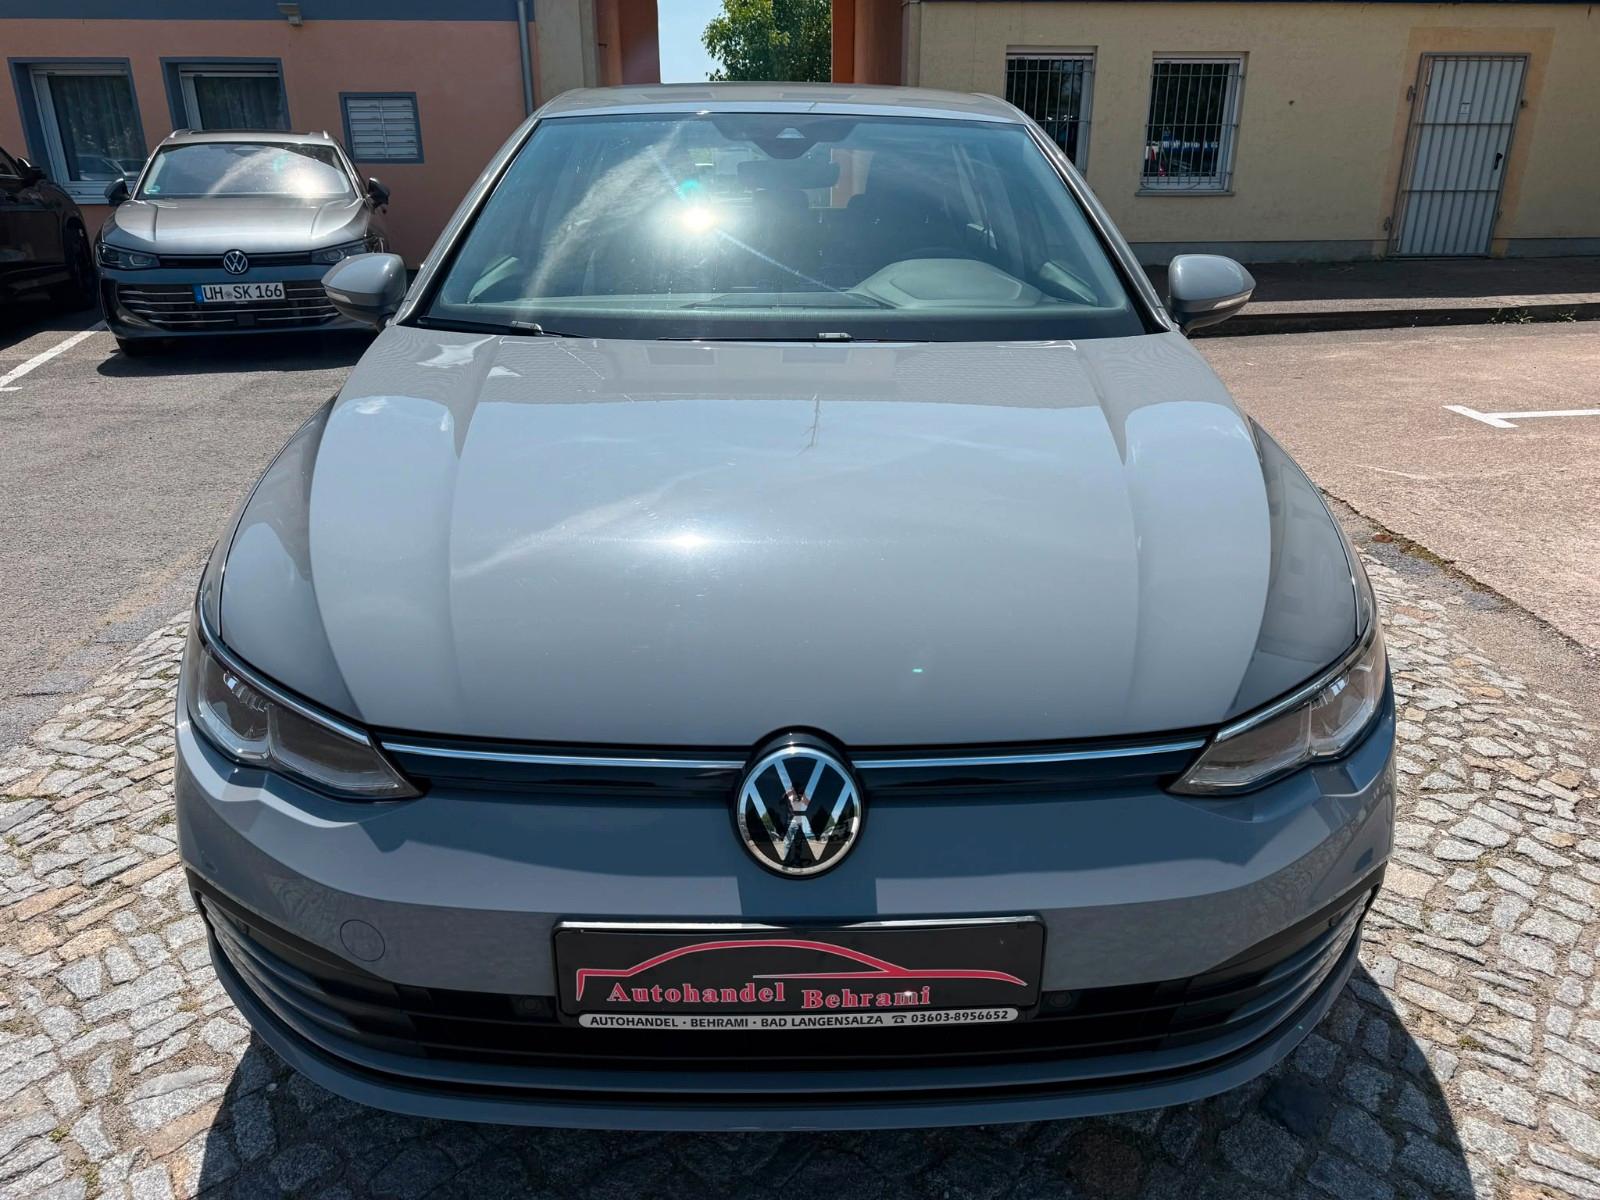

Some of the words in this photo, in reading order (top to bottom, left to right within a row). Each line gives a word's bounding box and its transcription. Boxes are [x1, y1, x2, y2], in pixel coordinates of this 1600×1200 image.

[203, 285, 224, 300] UH
[233, 285, 252, 299] SK
[255, 284, 283, 299] 166
[606, 982, 786, 1003] Autohandel
[801, 986, 931, 1009] Behrami
[590, 1016, 679, 1028] AUTOHANDEL
[690, 1017, 749, 1028] BEHRAMI
[760, 1017, 788, 1028] BAD
[791, 1015, 884, 1027] LANGENSALZA
[911, 1010, 1009, 1024] 03603-8956652
